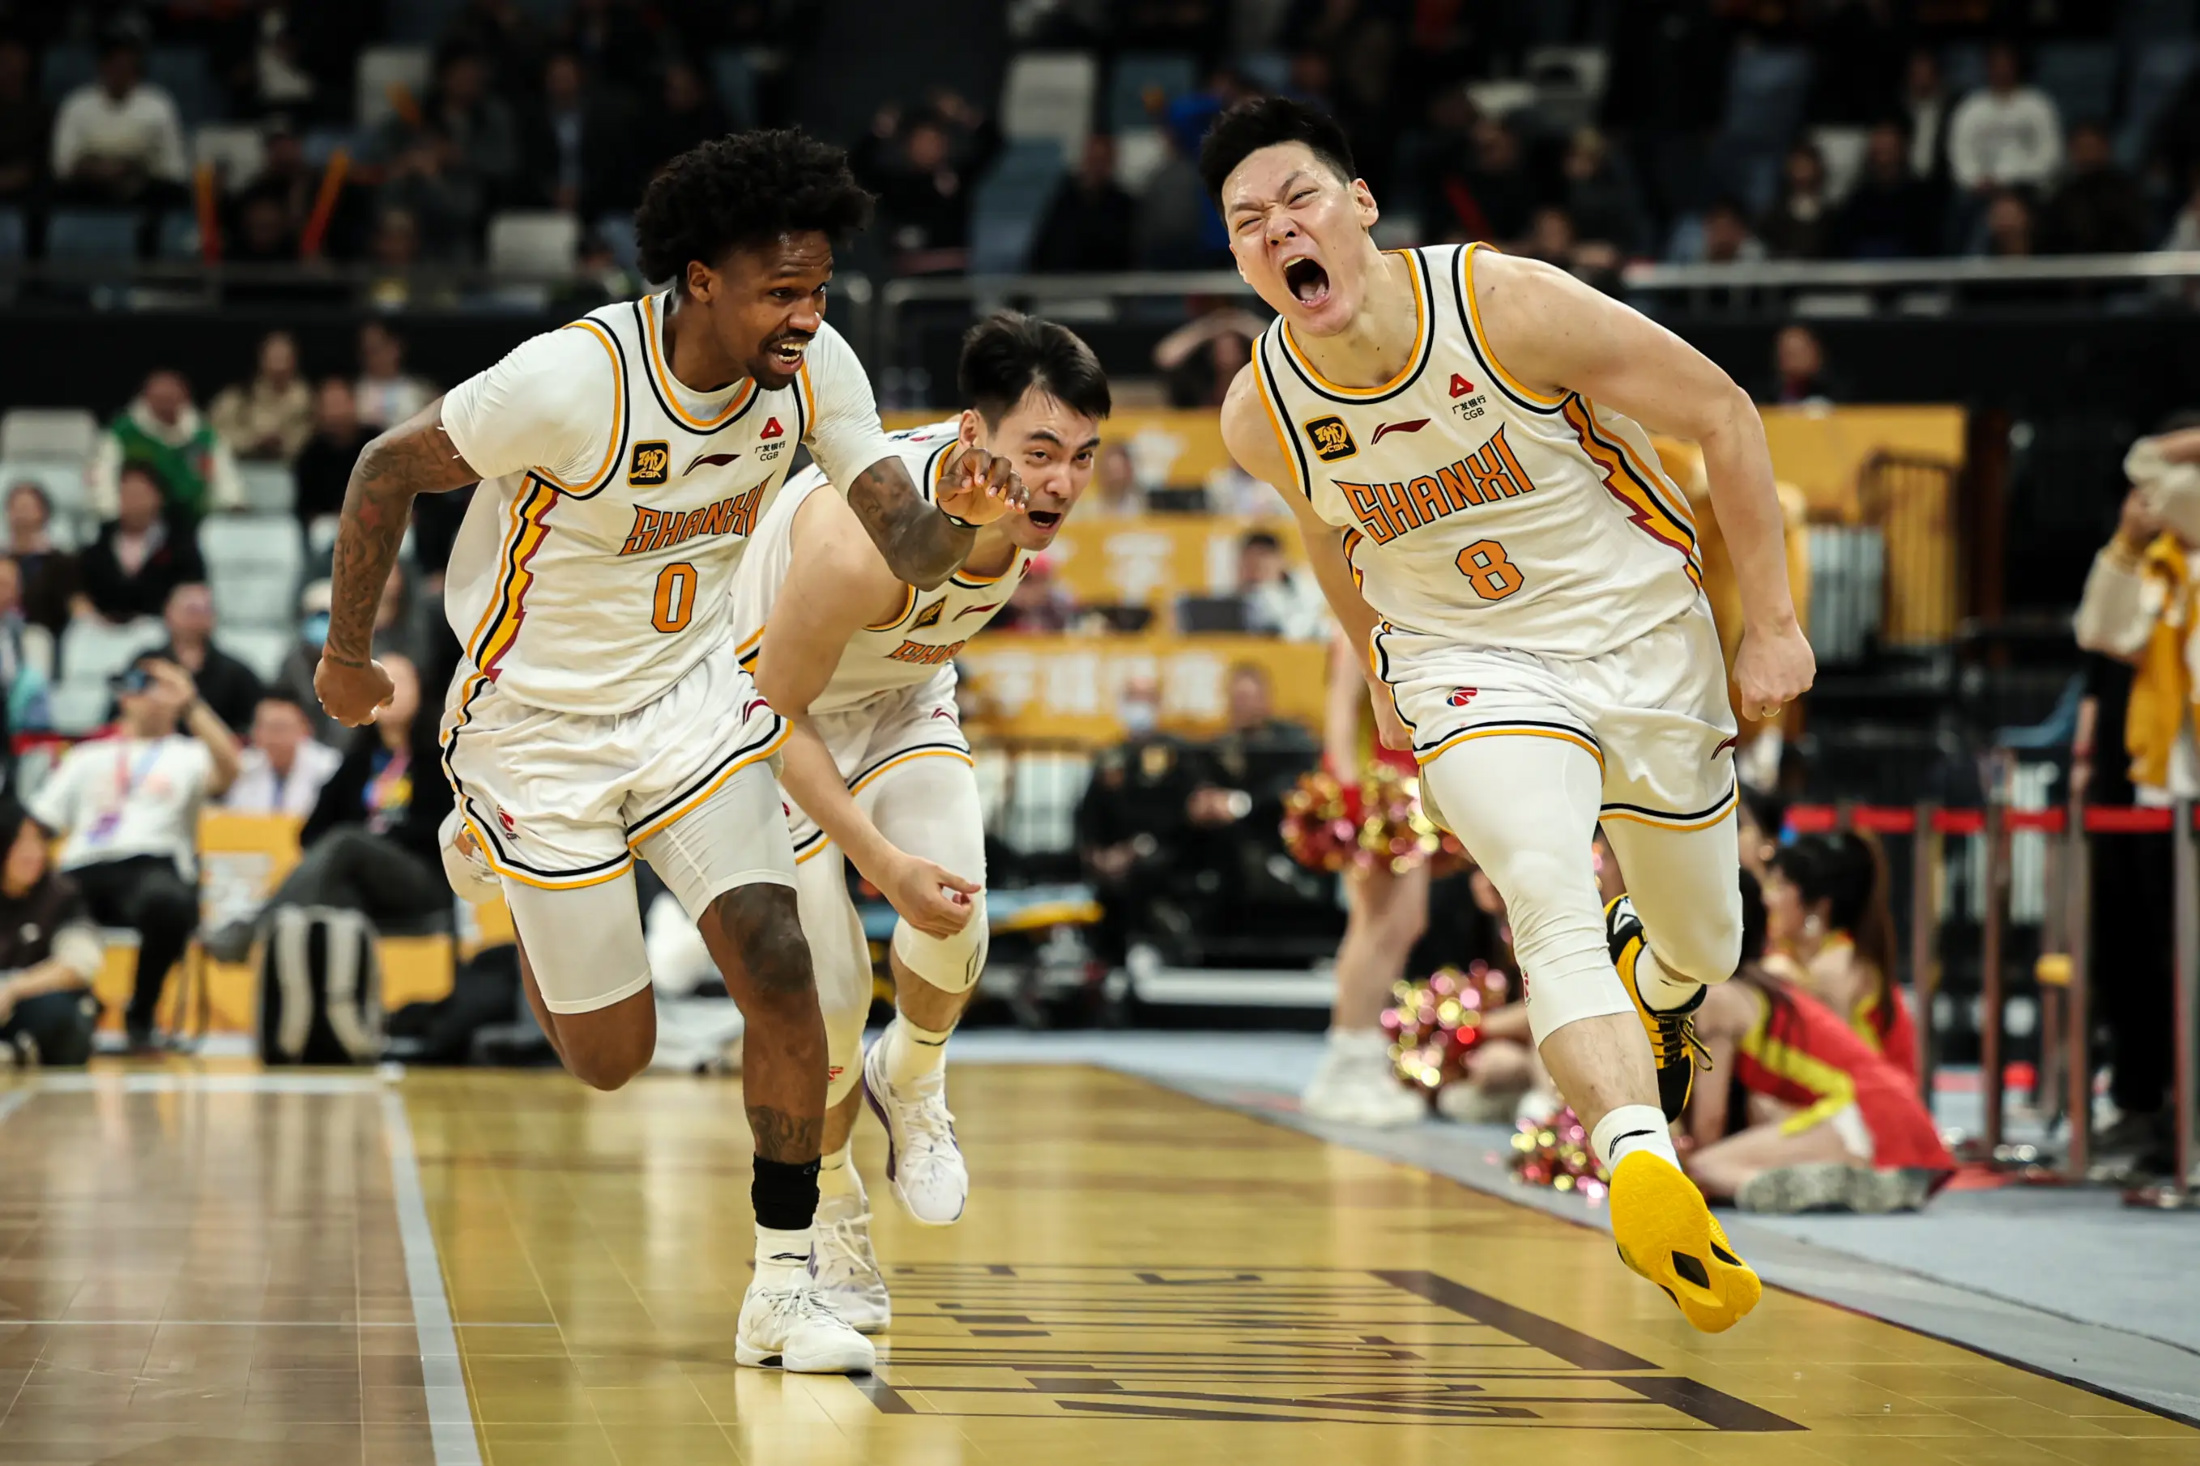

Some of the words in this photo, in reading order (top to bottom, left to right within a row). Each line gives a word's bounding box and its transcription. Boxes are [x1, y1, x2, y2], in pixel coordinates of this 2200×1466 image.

[1452, 395, 1487, 415] 广发银行
[1463, 407, 1485, 420] CGB
[754, 440, 786, 454] 广发银行
[760, 451, 779, 461] CGB
[1330, 421, 1536, 546] SHANXI
[617, 470, 777, 557] SHANXI
[1455, 539, 1525, 601] 8
[651, 562, 698, 633] 0
